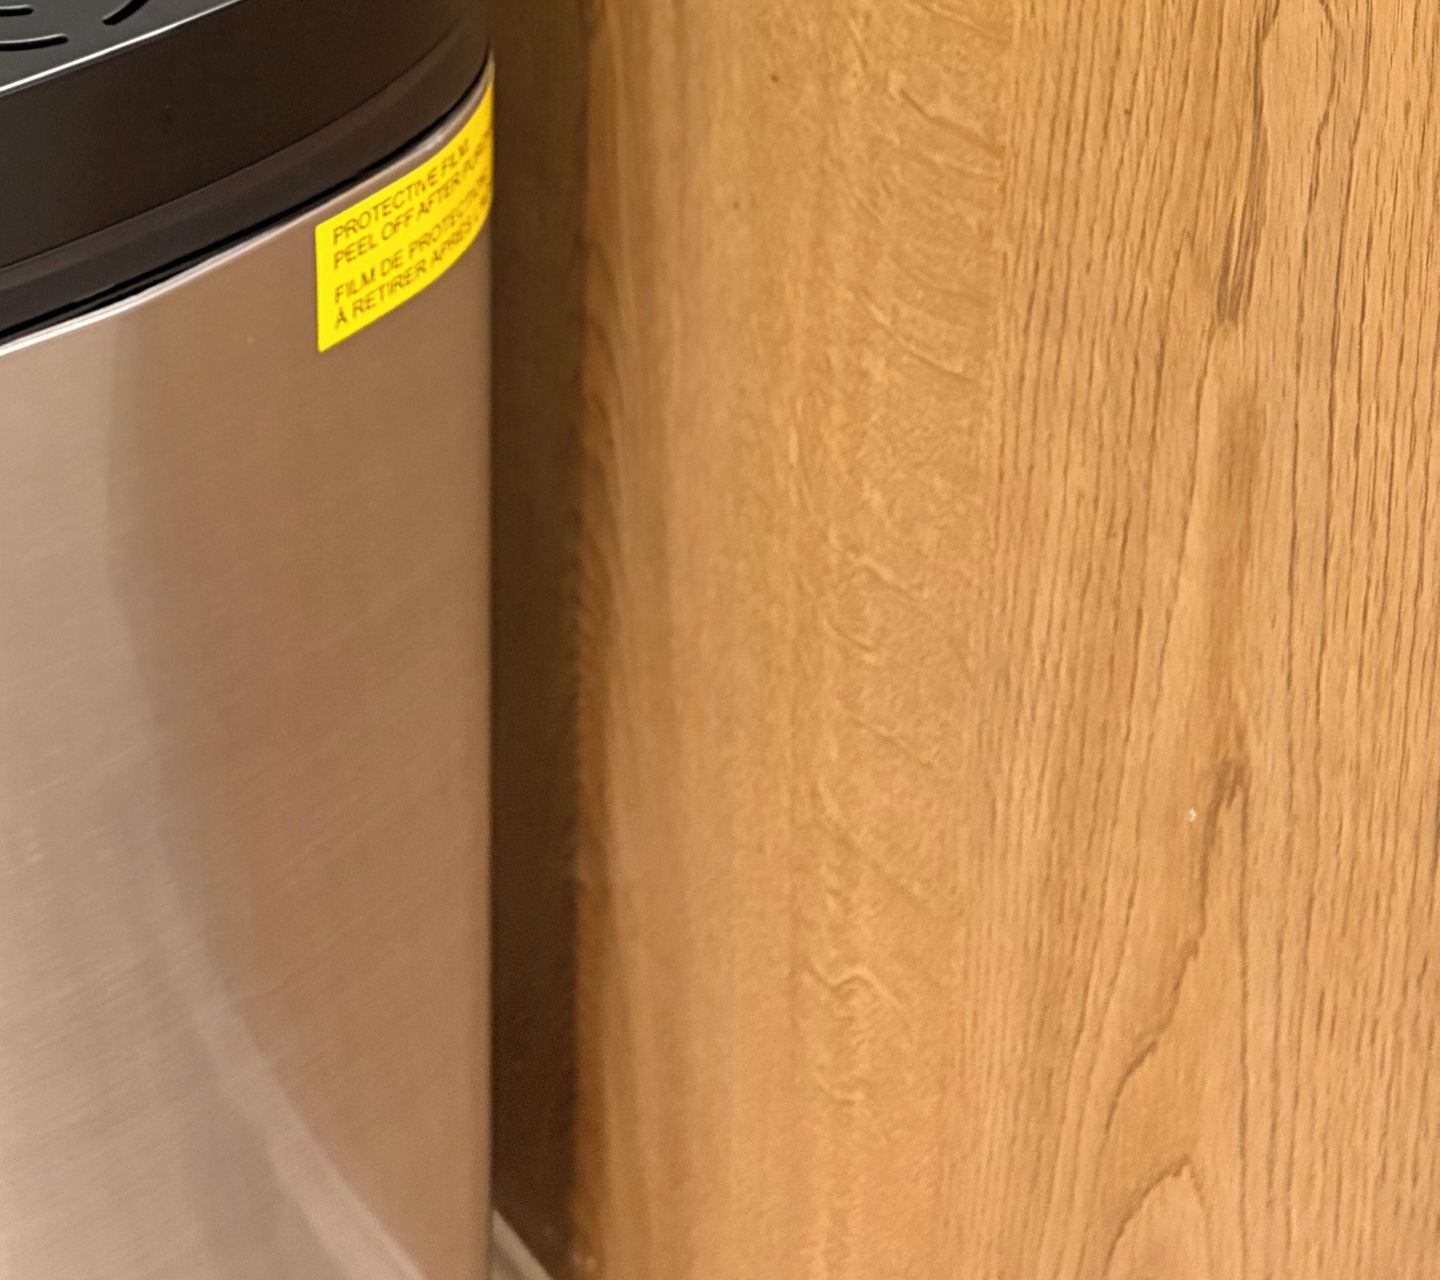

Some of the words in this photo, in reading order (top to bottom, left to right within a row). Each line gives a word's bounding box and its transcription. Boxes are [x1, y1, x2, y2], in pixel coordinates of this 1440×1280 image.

[333, 166, 438, 246] PROTECTIVE
[334, 232, 378, 271] PEEL
[381, 206, 416, 241] OFF
[334, 266, 376, 304] FILM
[380, 248, 404, 278] DE
[352, 258, 429, 318] RETIRER
